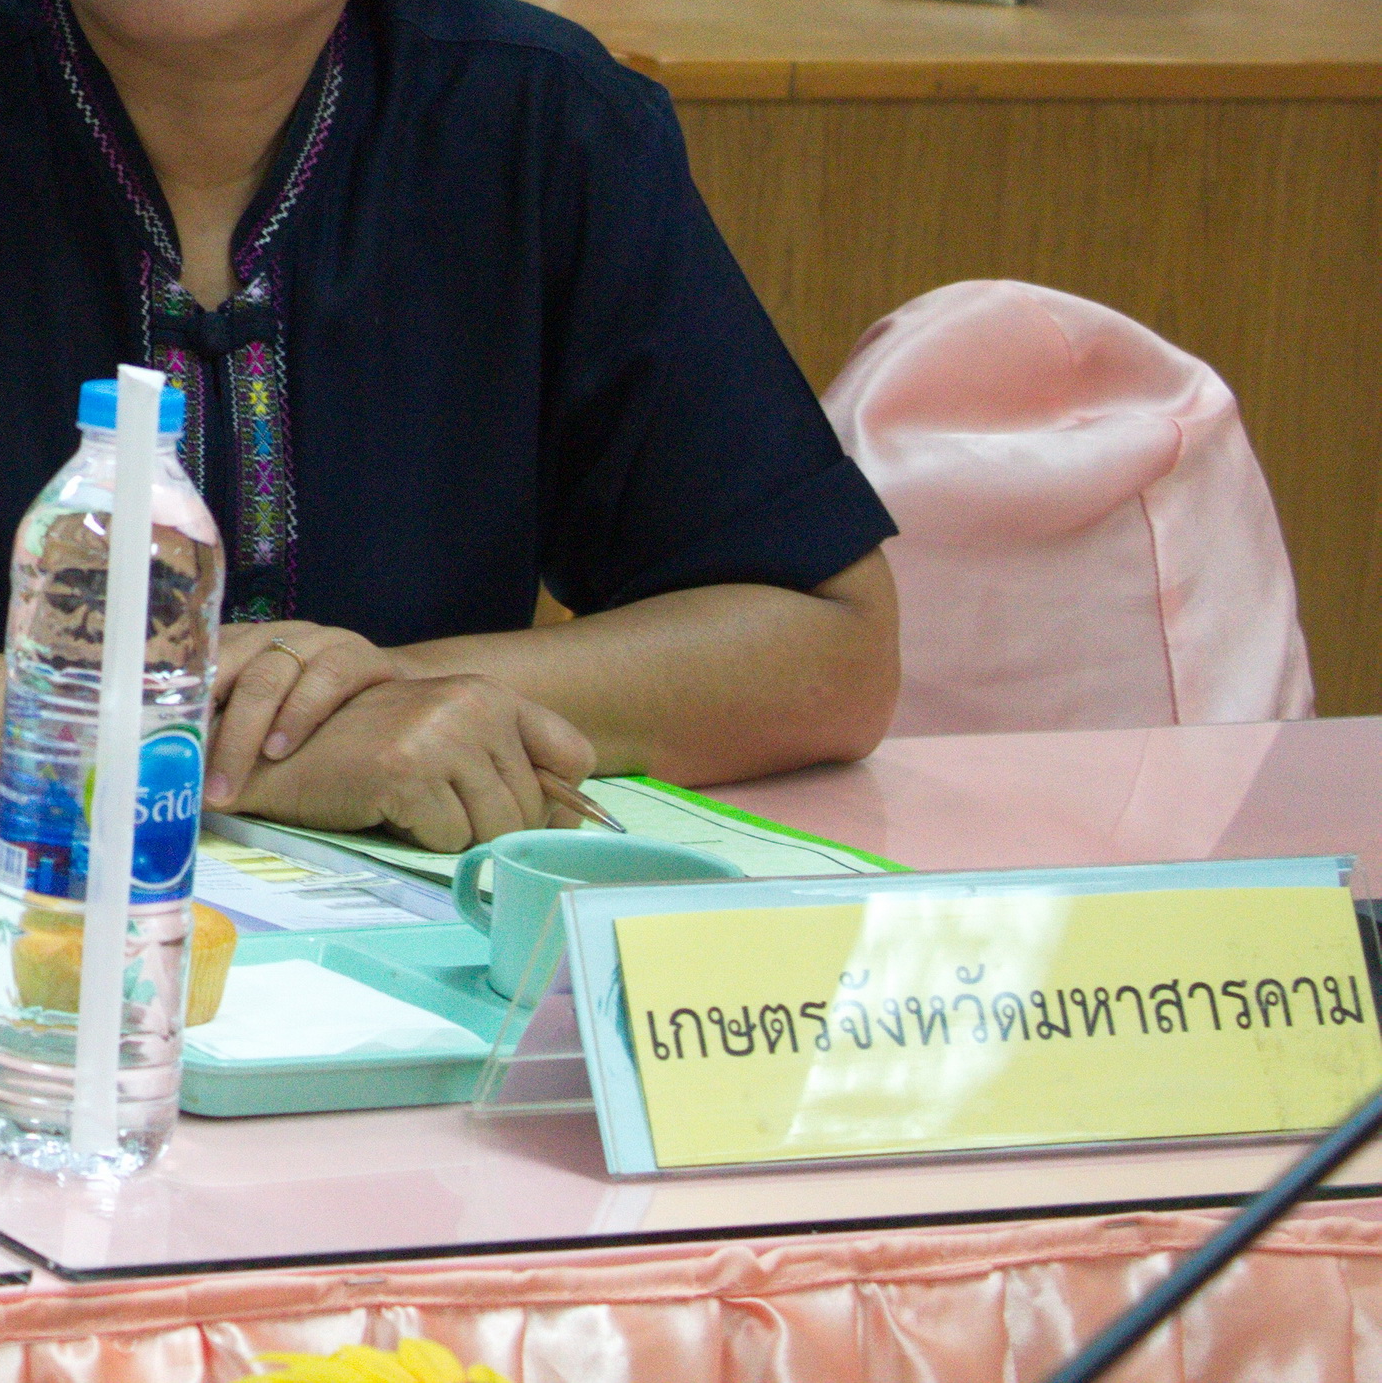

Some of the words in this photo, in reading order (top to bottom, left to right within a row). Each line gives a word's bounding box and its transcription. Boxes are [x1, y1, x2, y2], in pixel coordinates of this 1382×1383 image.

[646, 963, 1365, 1061] เกษตรจังหวัดมหาสารคาม
